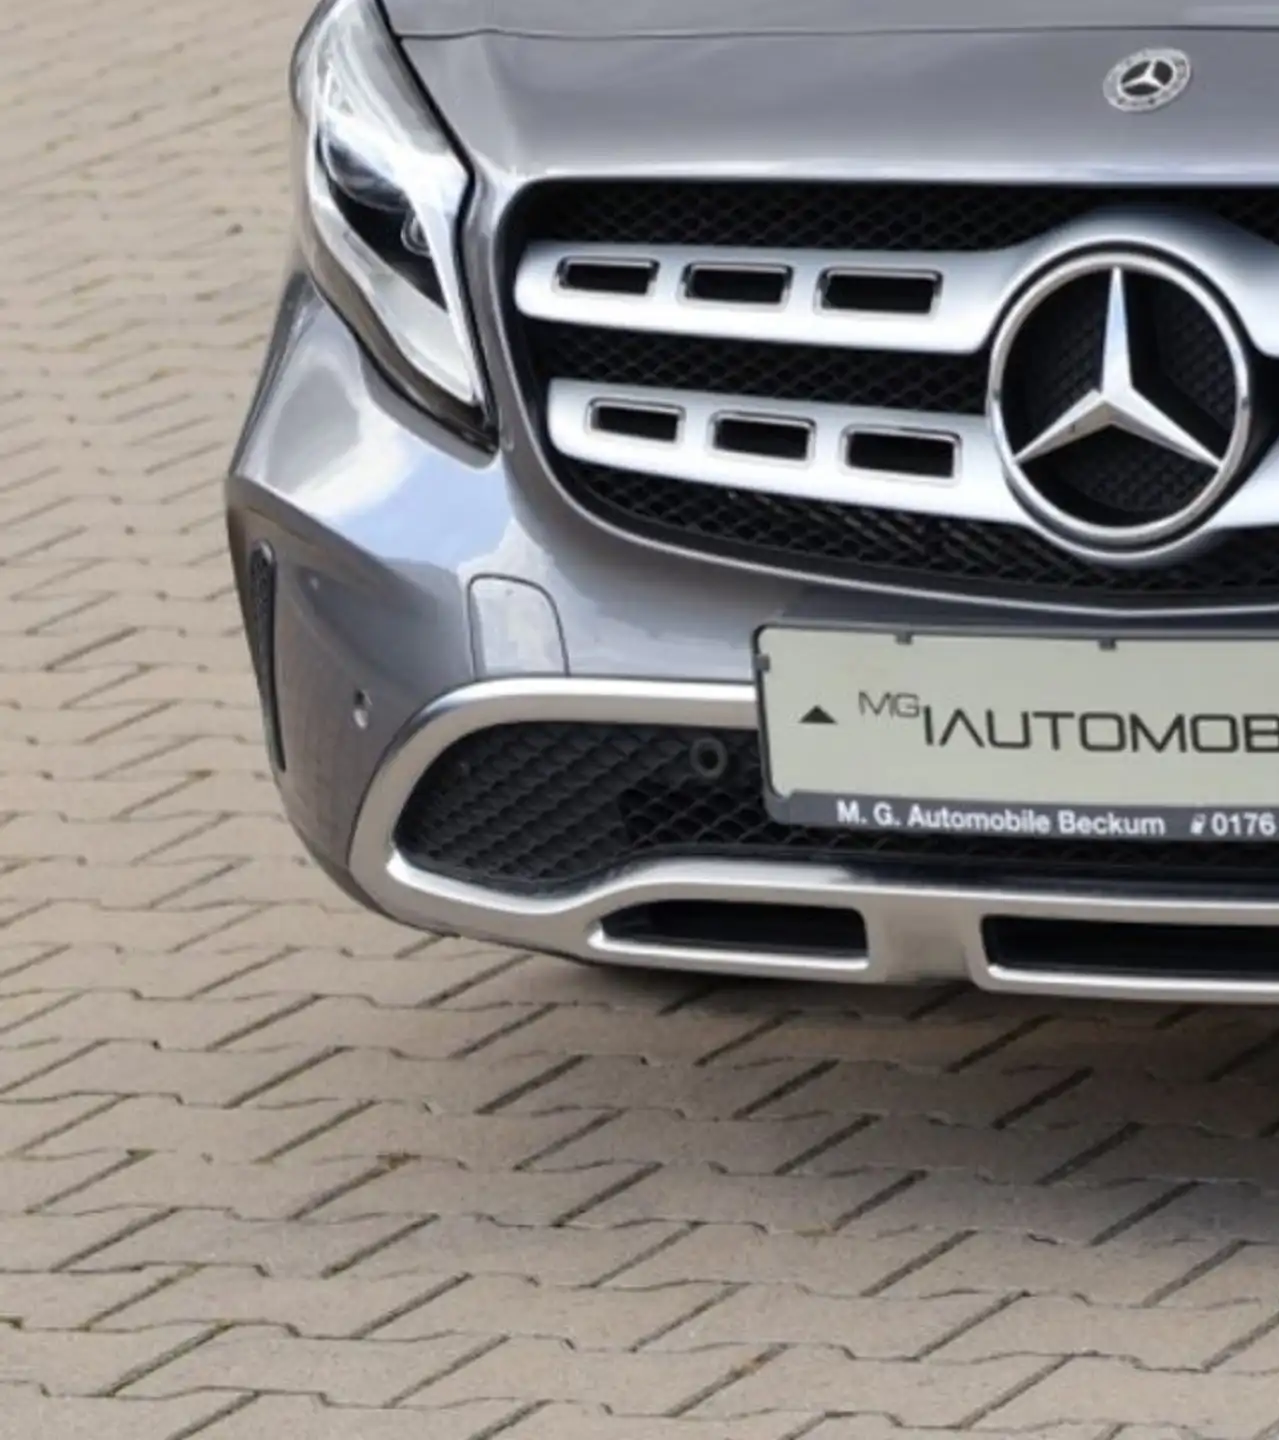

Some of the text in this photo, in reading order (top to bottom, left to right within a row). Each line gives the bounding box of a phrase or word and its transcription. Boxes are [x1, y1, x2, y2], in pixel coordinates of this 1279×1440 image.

[858, 691, 920, 718] MG
[836, 799, 867, 826] M.
[872, 801, 901, 827] G.
[907, 803, 1051, 835] Automobile
[1057, 809, 1166, 836] Beckum
[1210, 812, 1278, 836] 0176
